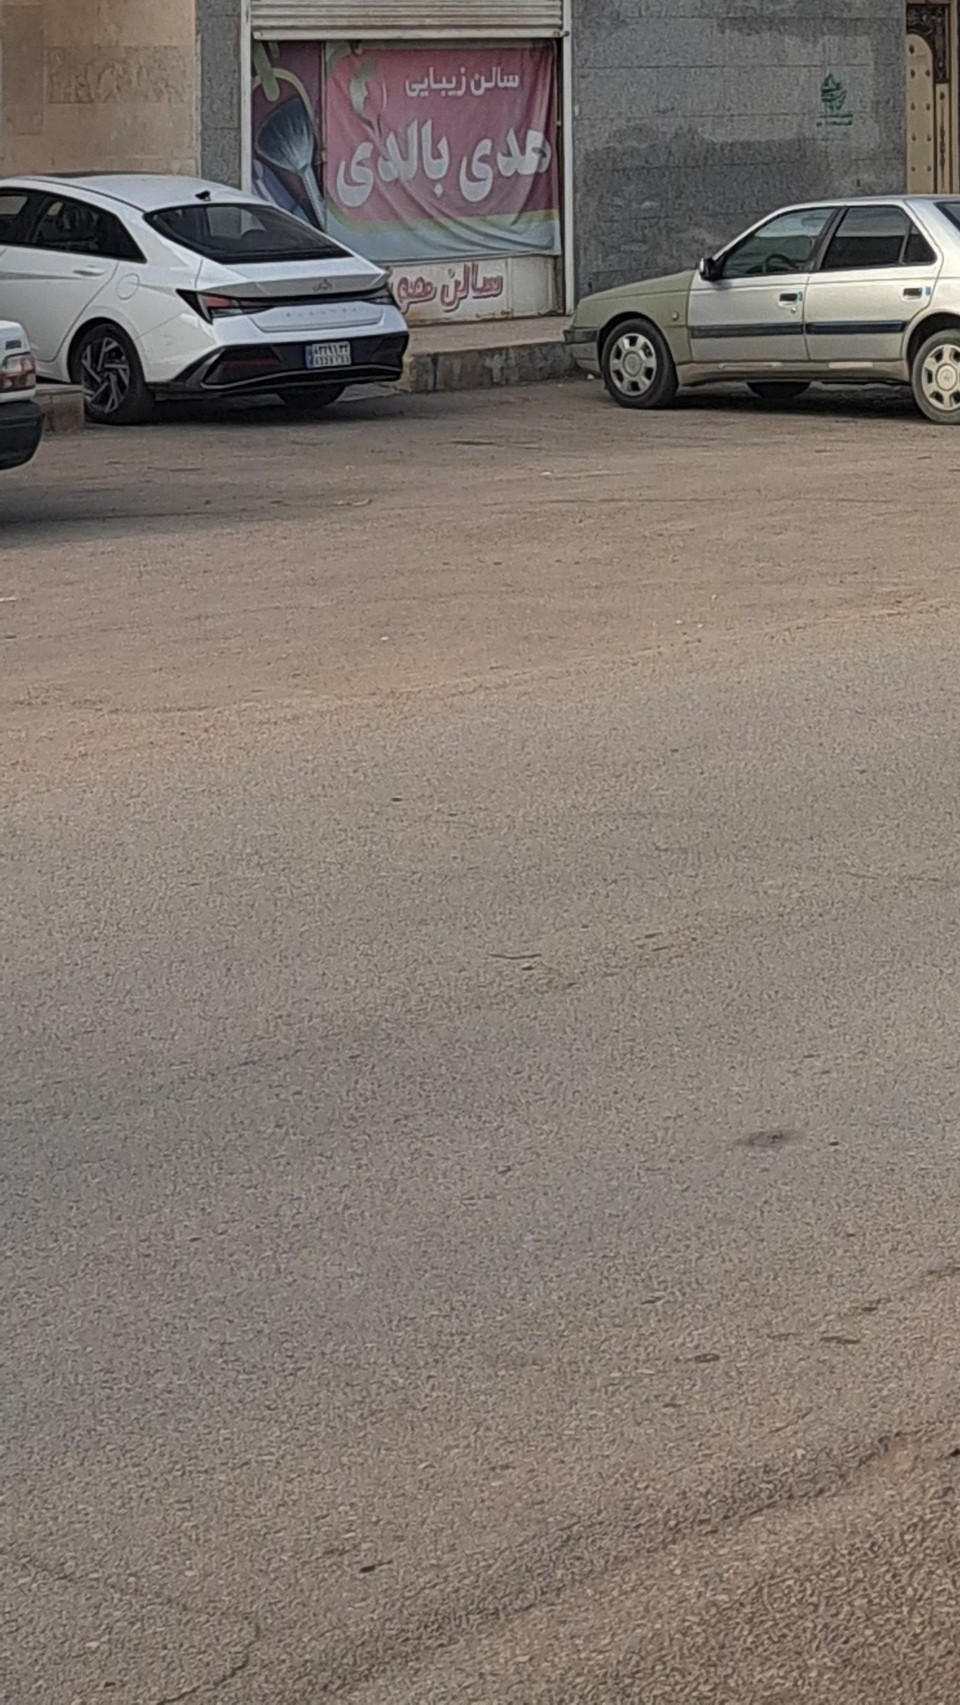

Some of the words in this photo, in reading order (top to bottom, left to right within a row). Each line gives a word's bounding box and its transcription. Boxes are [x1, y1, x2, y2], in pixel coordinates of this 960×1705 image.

[404, 65, 467, 97] زیبایی
[469, 65, 520, 96] سالن
[335, 120, 450, 208] بالدی
[440, 261, 504, 312] سالن
